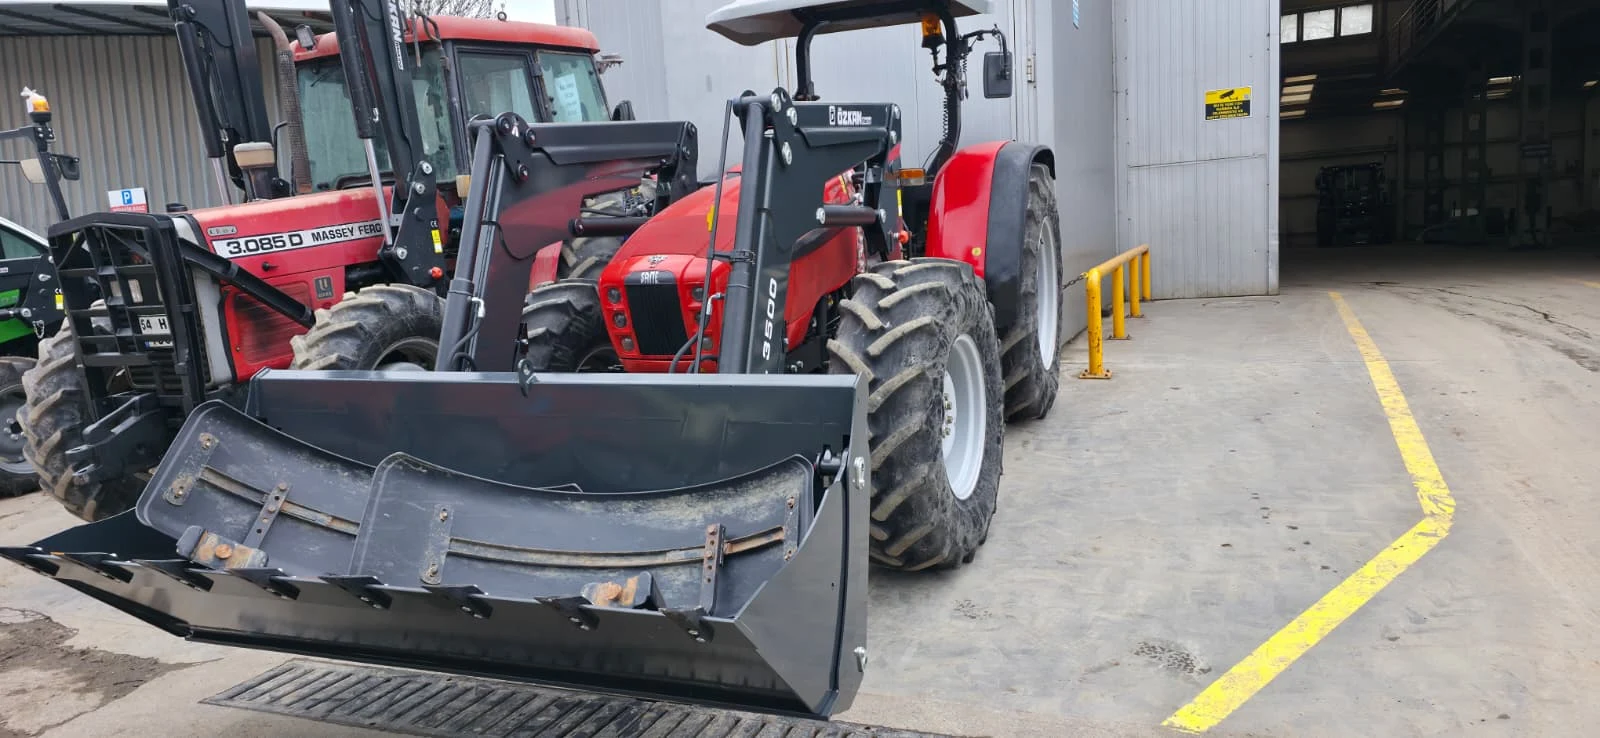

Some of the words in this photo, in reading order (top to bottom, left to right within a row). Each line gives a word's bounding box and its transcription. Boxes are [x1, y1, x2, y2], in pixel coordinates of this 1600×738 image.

[388, 0, 402, 42] KAN
[837, 106, 862, 125] ÖZKAN
[123, 191, 132, 204] P
[226, 235, 286, 255] 3.085
[289, 233, 303, 247] D
[311, 226, 355, 242] MASSEY
[358, 221, 384, 235] FERG
[641, 270, 659, 285] SAME
[158, 318, 167, 330] H
[762, 277, 777, 361] 3500
